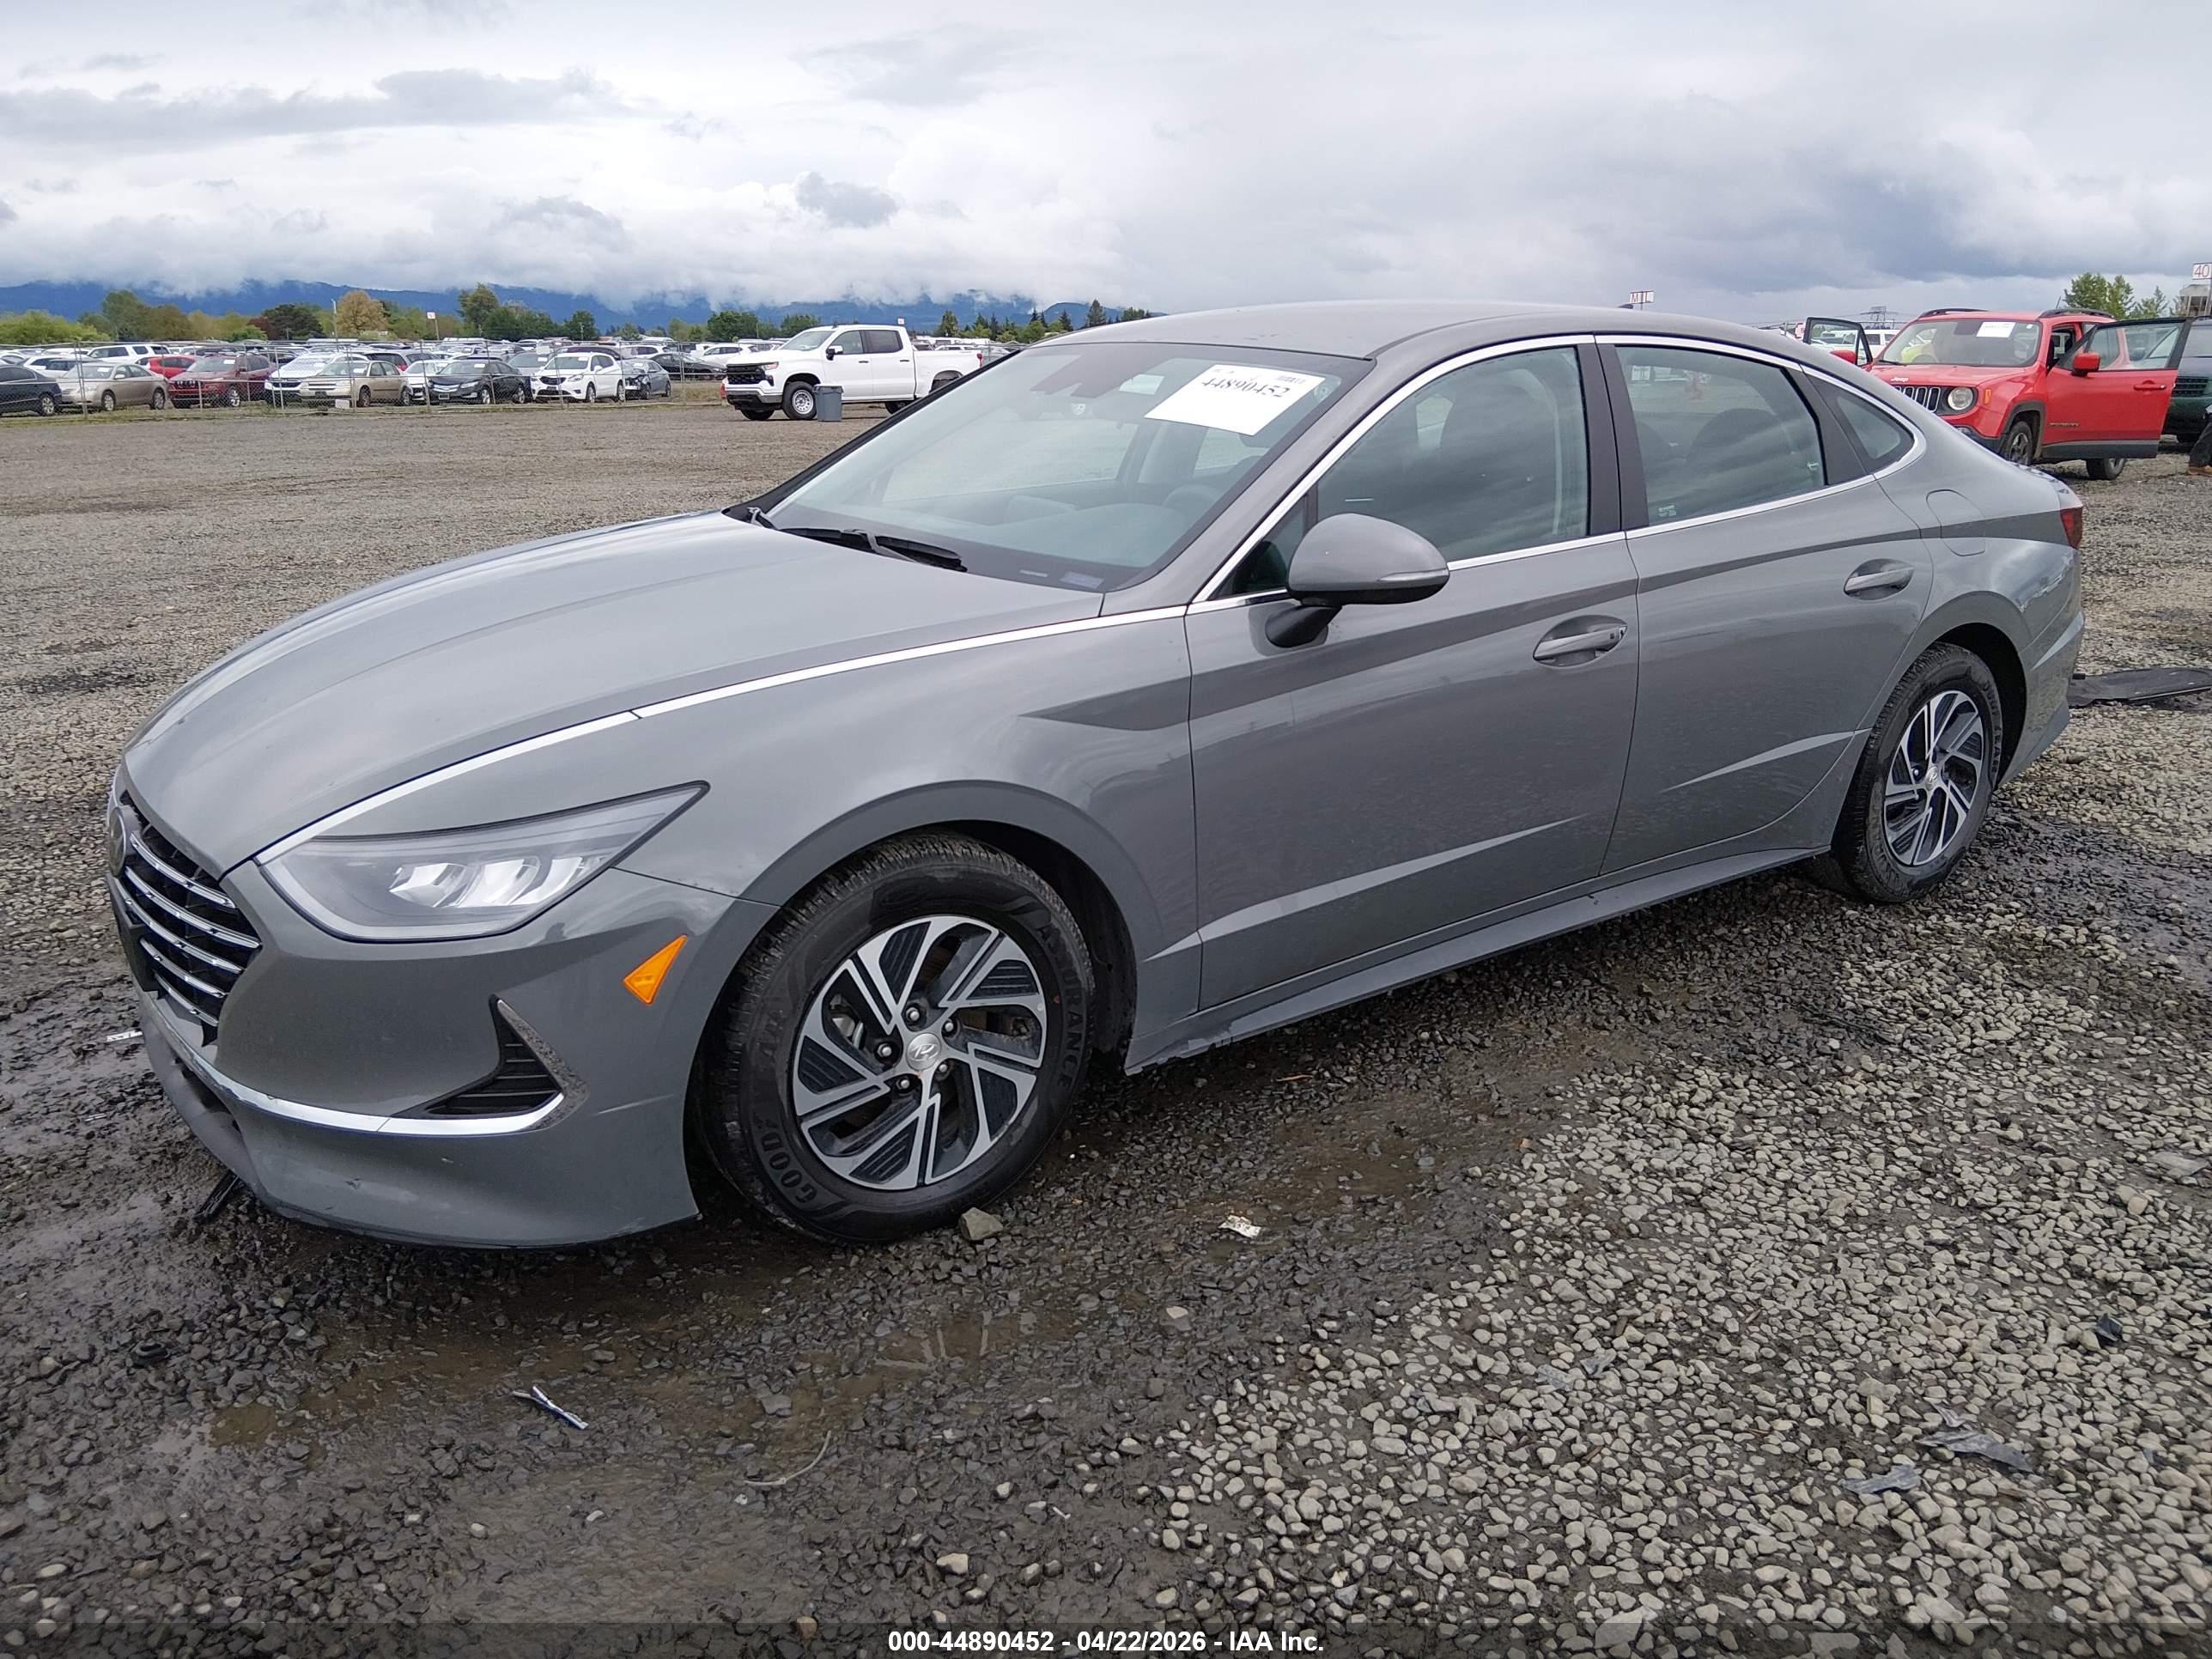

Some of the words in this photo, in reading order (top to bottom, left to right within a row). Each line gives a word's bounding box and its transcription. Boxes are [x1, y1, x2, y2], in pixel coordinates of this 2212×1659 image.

[2194, 264, 2209, 277] 40
[1200, 377, 1291, 398] 44890452
[1036, 925, 1085, 1089] AURANCE
